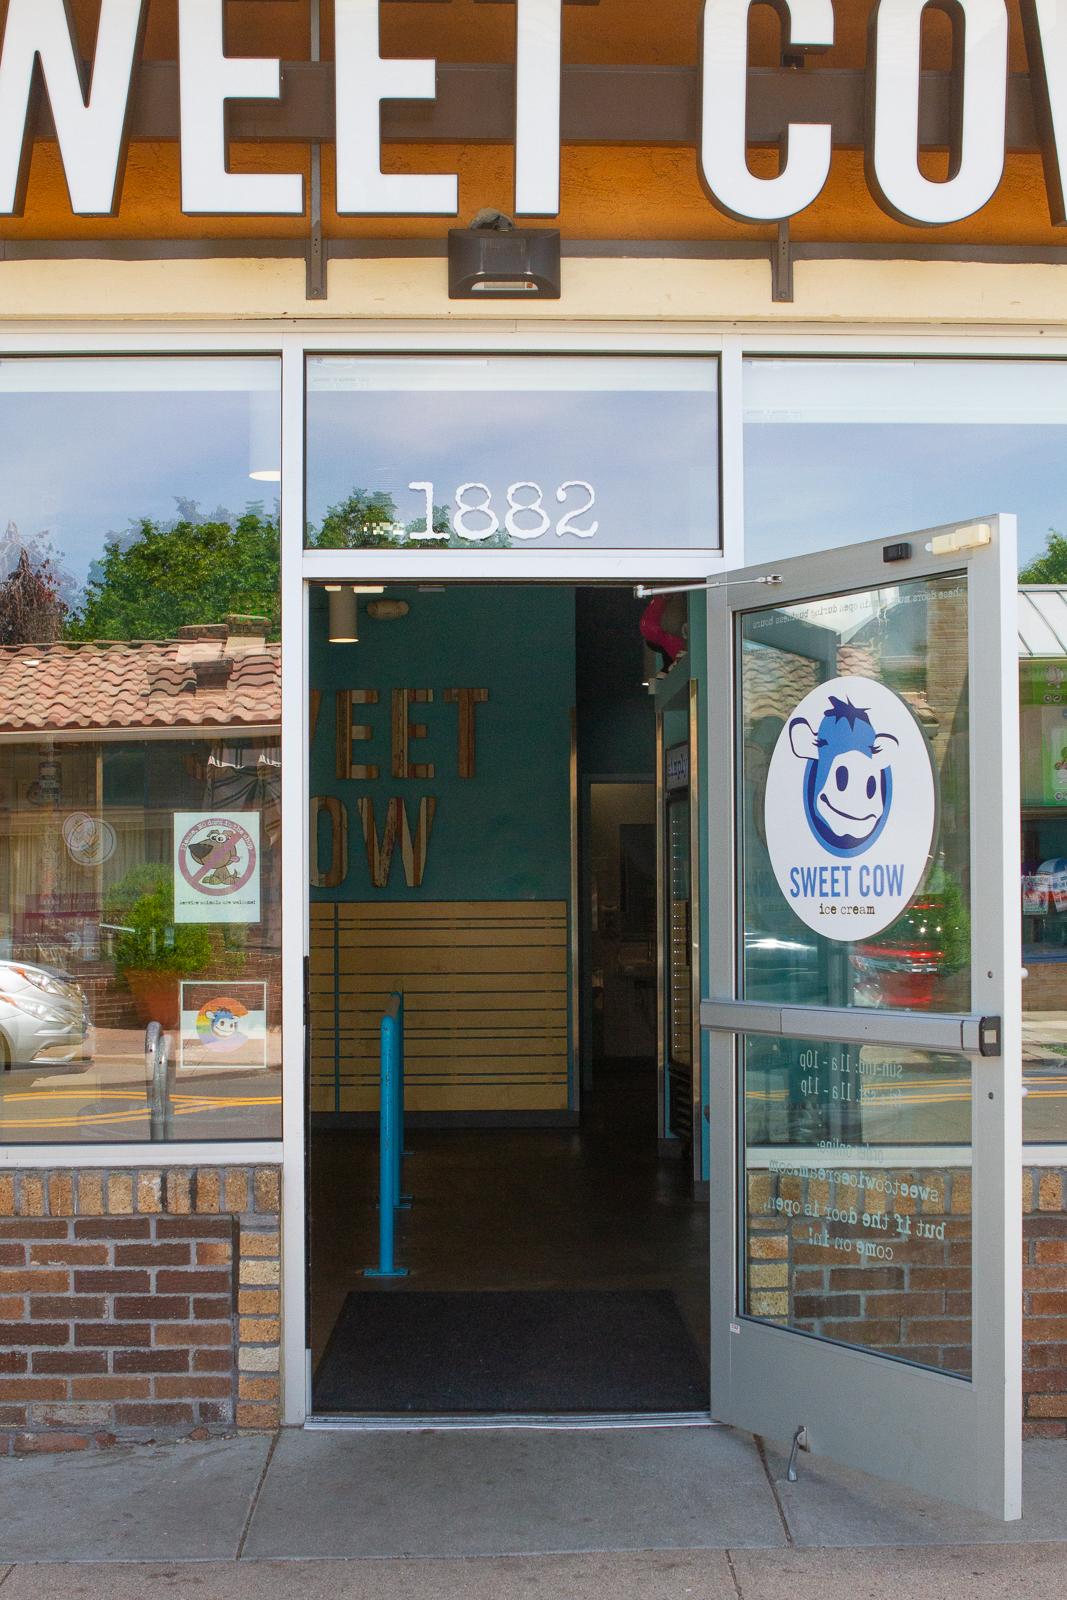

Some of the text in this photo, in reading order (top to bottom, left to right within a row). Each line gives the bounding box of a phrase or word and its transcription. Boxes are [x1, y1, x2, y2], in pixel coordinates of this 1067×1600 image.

[697, 0, 1067, 226] CO
[408, 480, 600, 542] 1882
[790, 863, 905, 898] SWEET COW
[819, 903, 875, 915] ice cream
